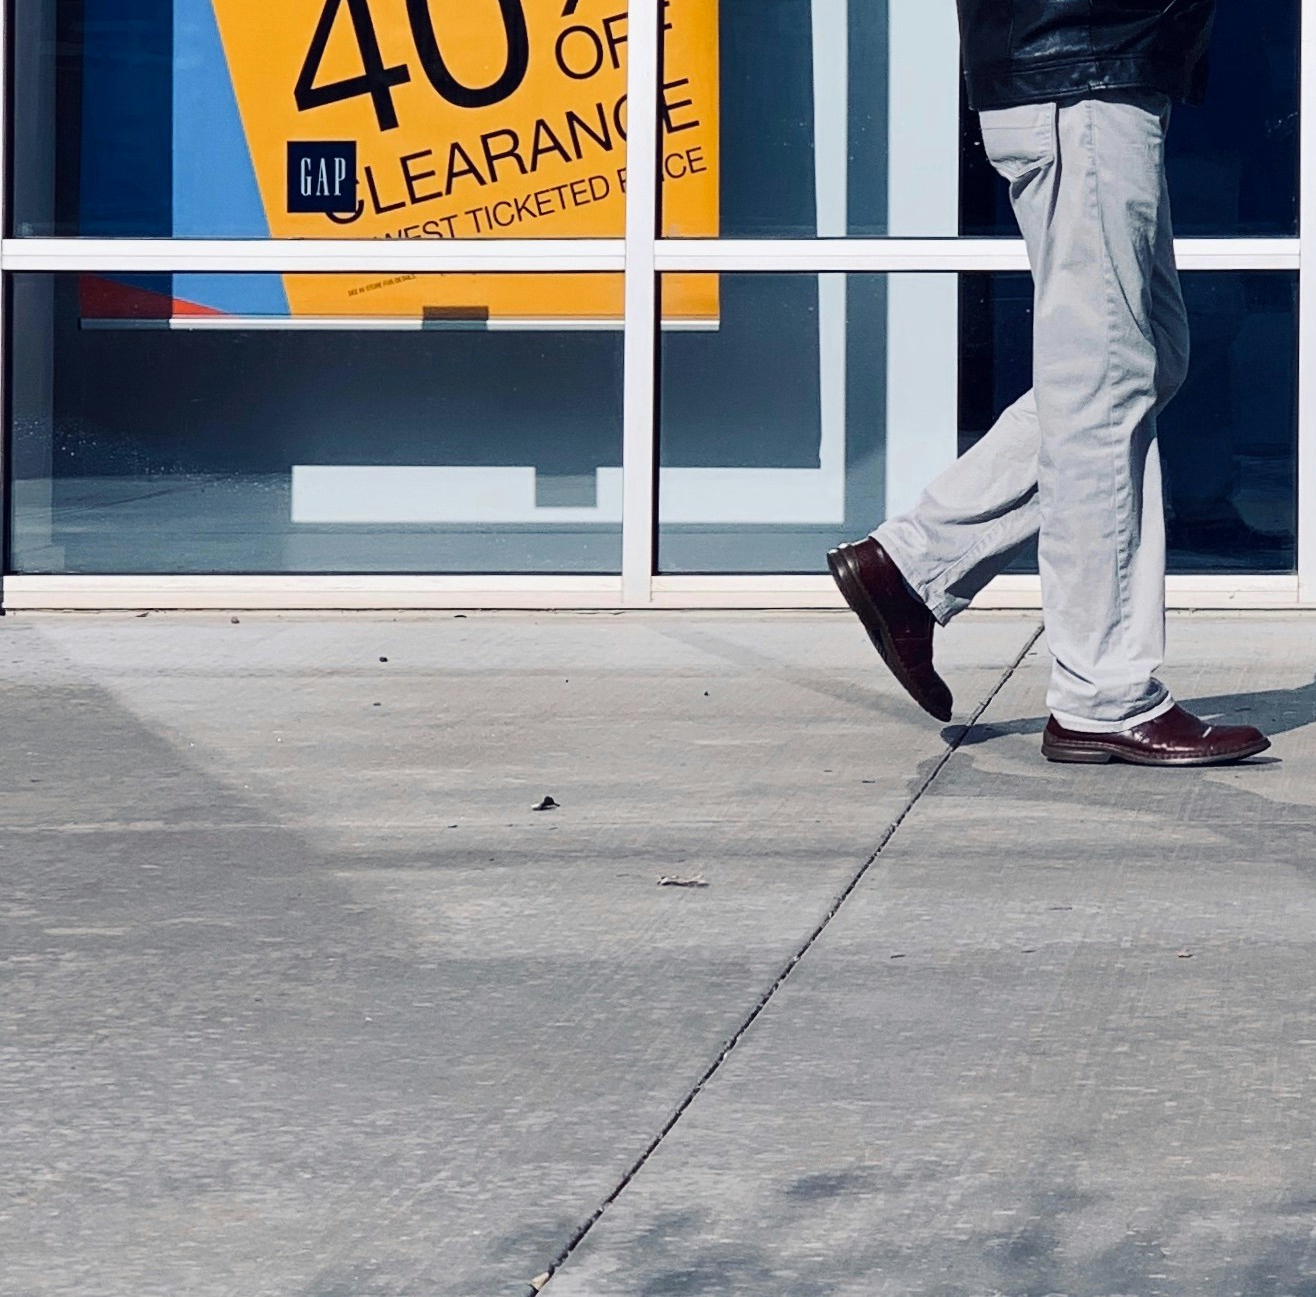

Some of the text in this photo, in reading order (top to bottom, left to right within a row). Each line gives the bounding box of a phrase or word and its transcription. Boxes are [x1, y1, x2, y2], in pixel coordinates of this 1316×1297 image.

[555, 1, 673, 80] OF
[300, 157, 346, 196] GAP
[464, 175, 610, 233] TICKETED
